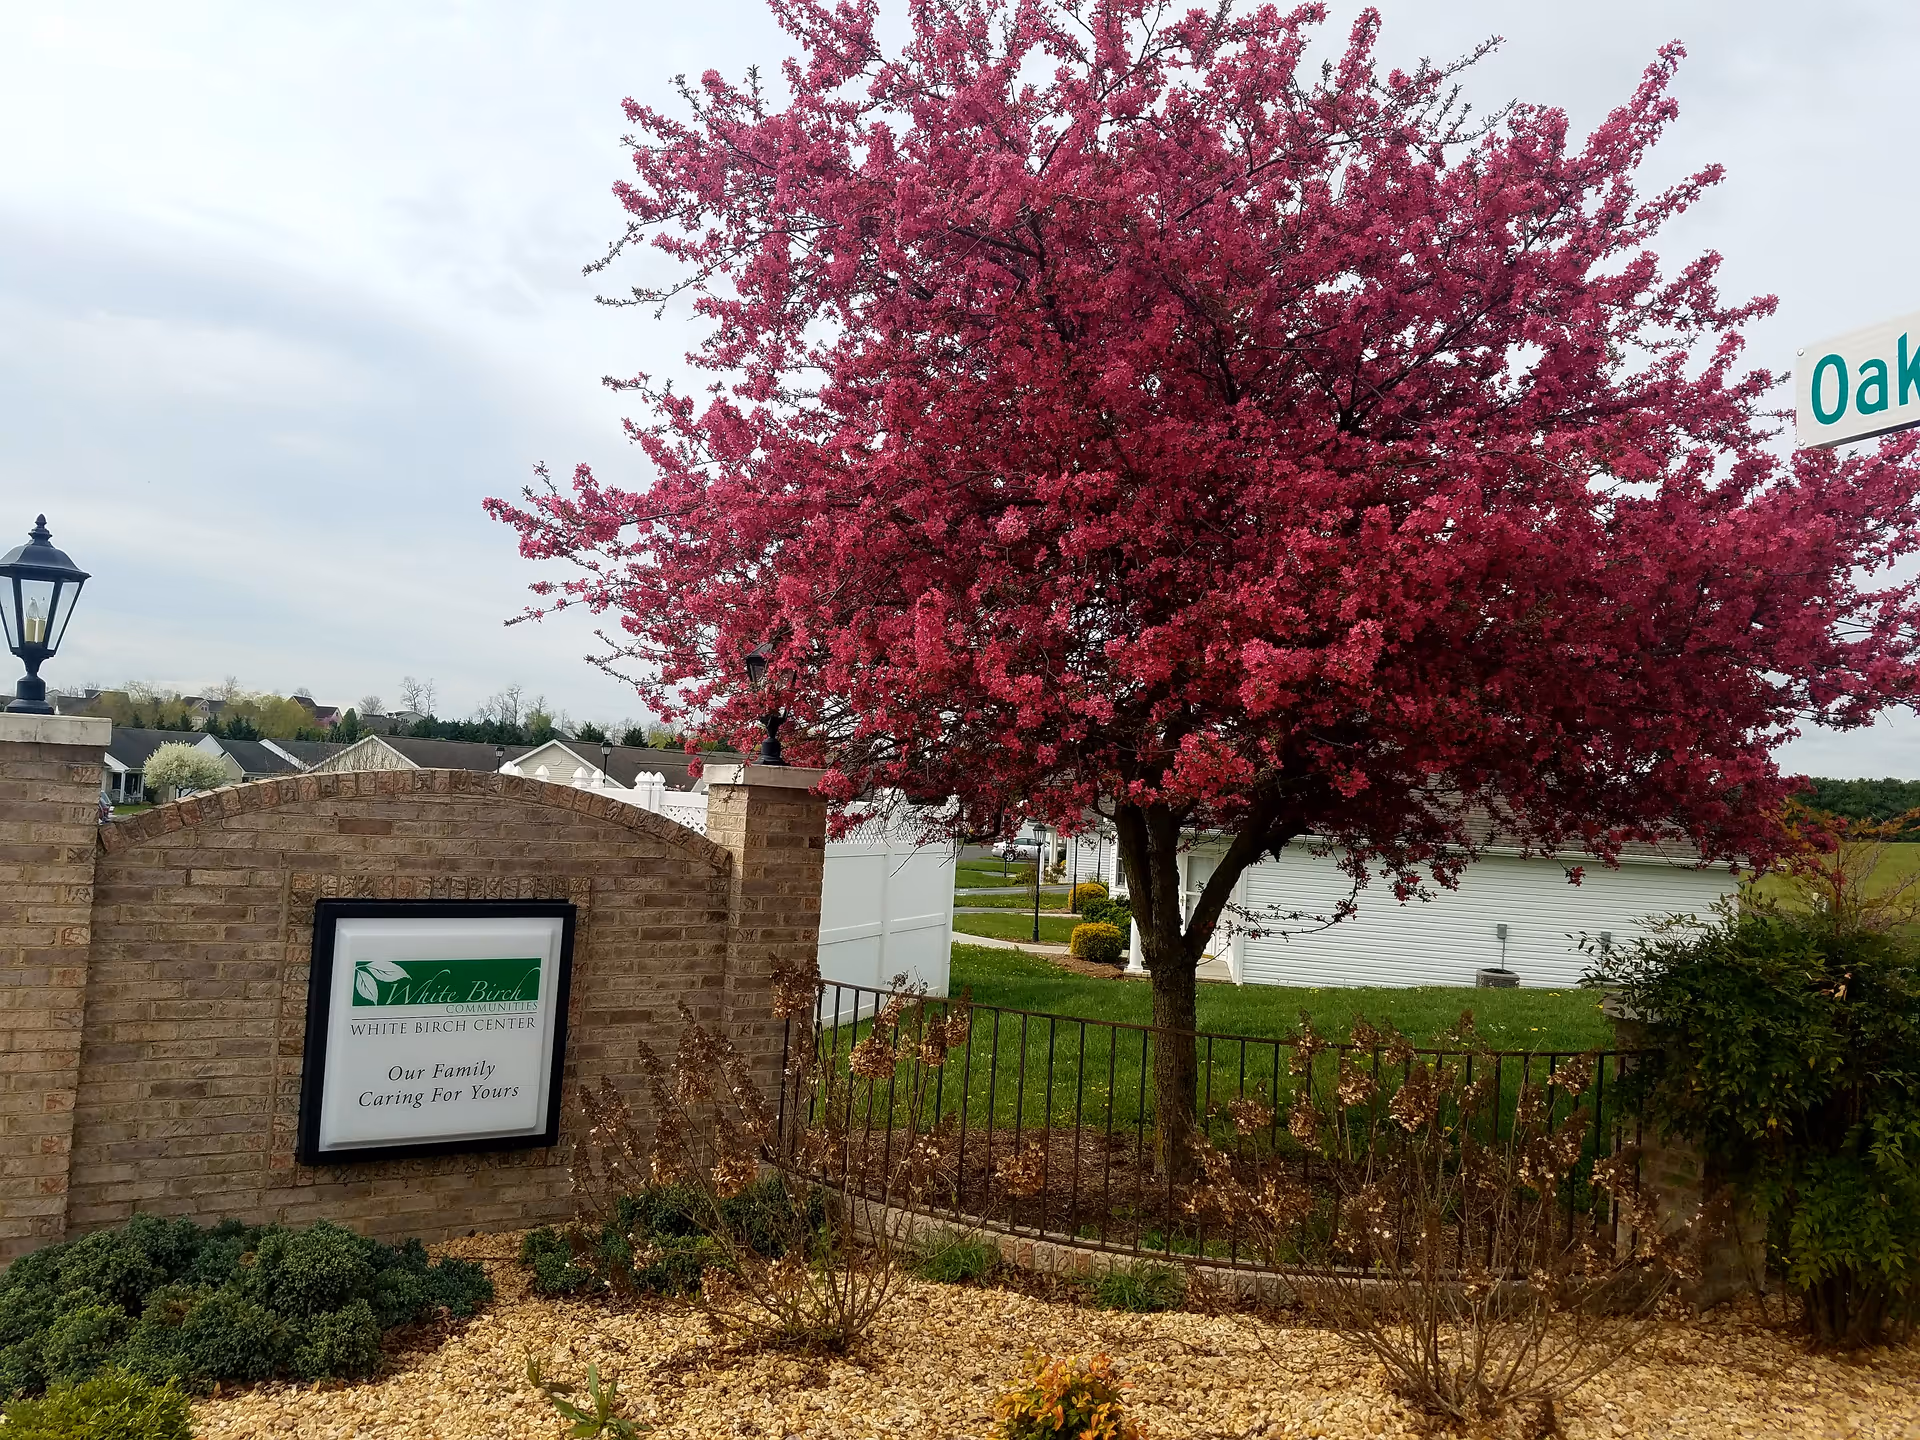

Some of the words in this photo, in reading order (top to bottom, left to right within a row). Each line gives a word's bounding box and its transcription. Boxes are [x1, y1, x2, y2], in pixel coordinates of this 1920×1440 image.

[385, 969, 460, 1005] White
[466, 967, 541, 1002] Birch
[445, 1001, 538, 1014] COMMUNITIES
[350, 1022, 407, 1036] WHITE
[415, 1020, 467, 1034] BIRCH
[473, 1017, 536, 1031] CENTER
[388, 1065, 426, 1081] Our
[431, 1060, 496, 1081] Family
[358, 1090, 425, 1109] Caring
[430, 1087, 463, 1103] For
[471, 1084, 520, 1100] Yours
